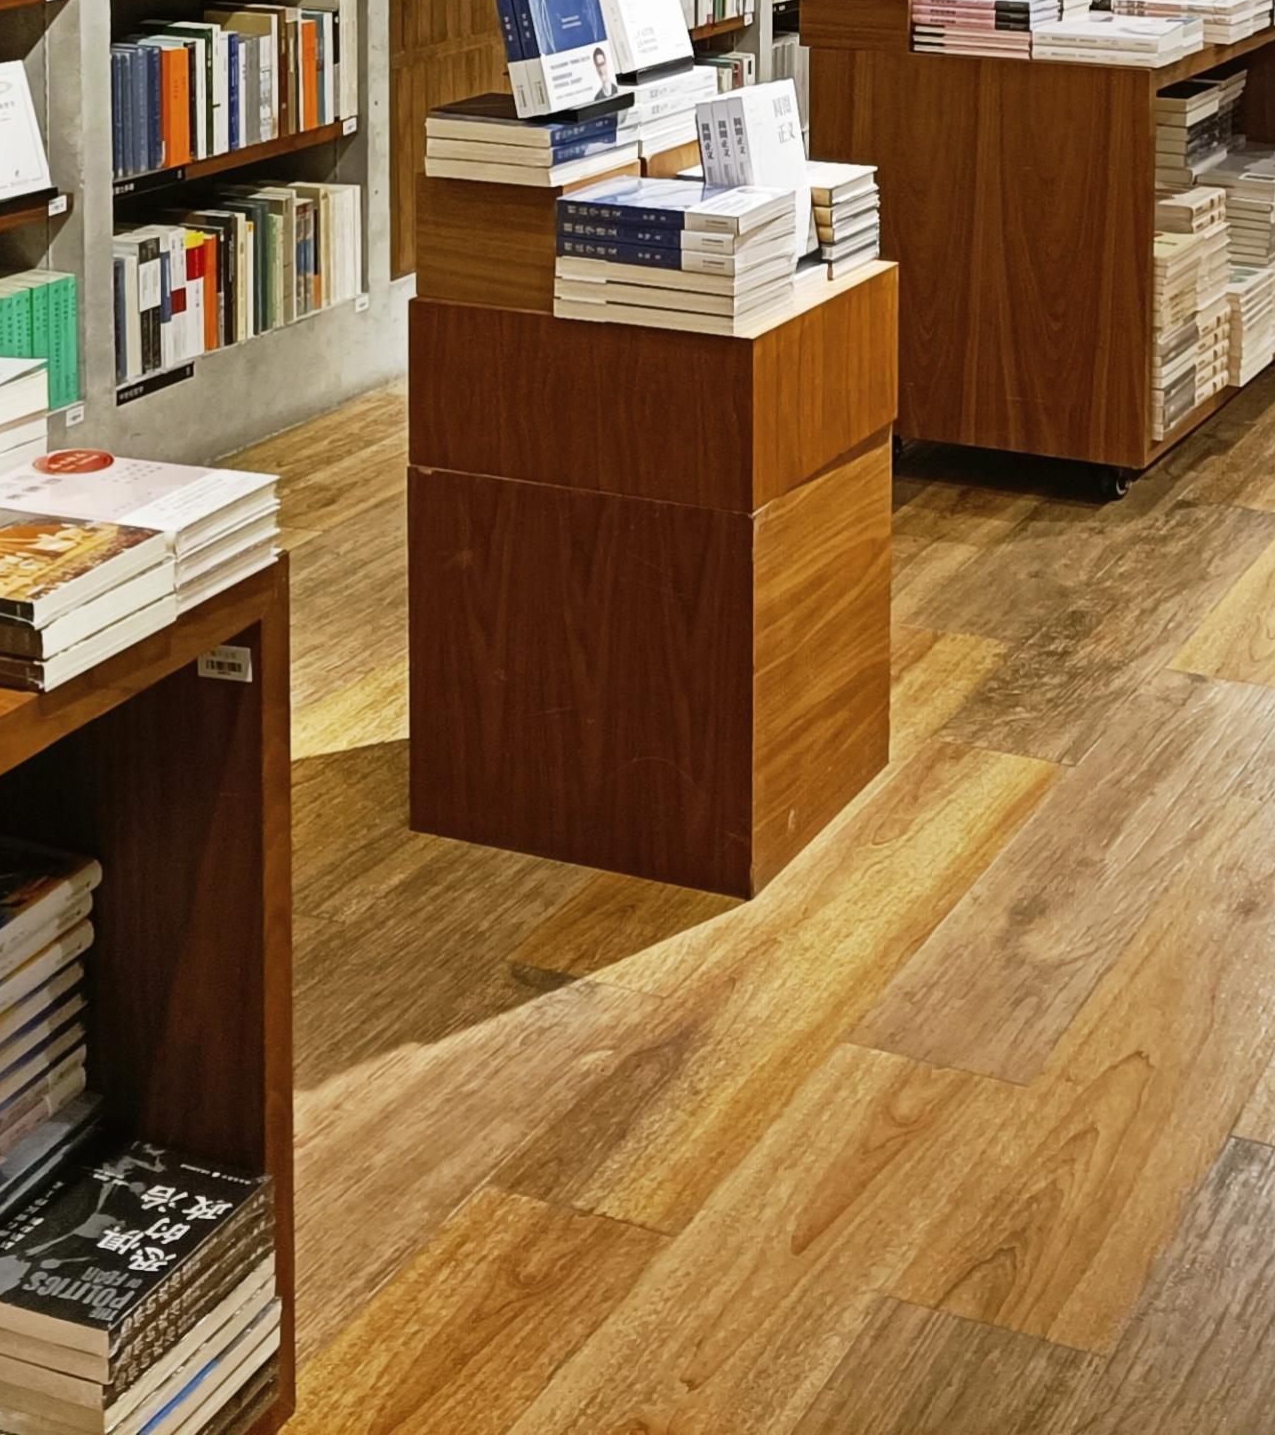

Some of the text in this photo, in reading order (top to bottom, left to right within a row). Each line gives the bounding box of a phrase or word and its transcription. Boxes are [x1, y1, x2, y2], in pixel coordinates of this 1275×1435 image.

[139, 1184, 234, 1220] 政治
[144, 1217, 191, 1244] 的
[96, 1226, 177, 1273] 恐惧
[22, 1270, 135, 1309] POLITICS
[79, 1265, 122, 1283] FEAR
